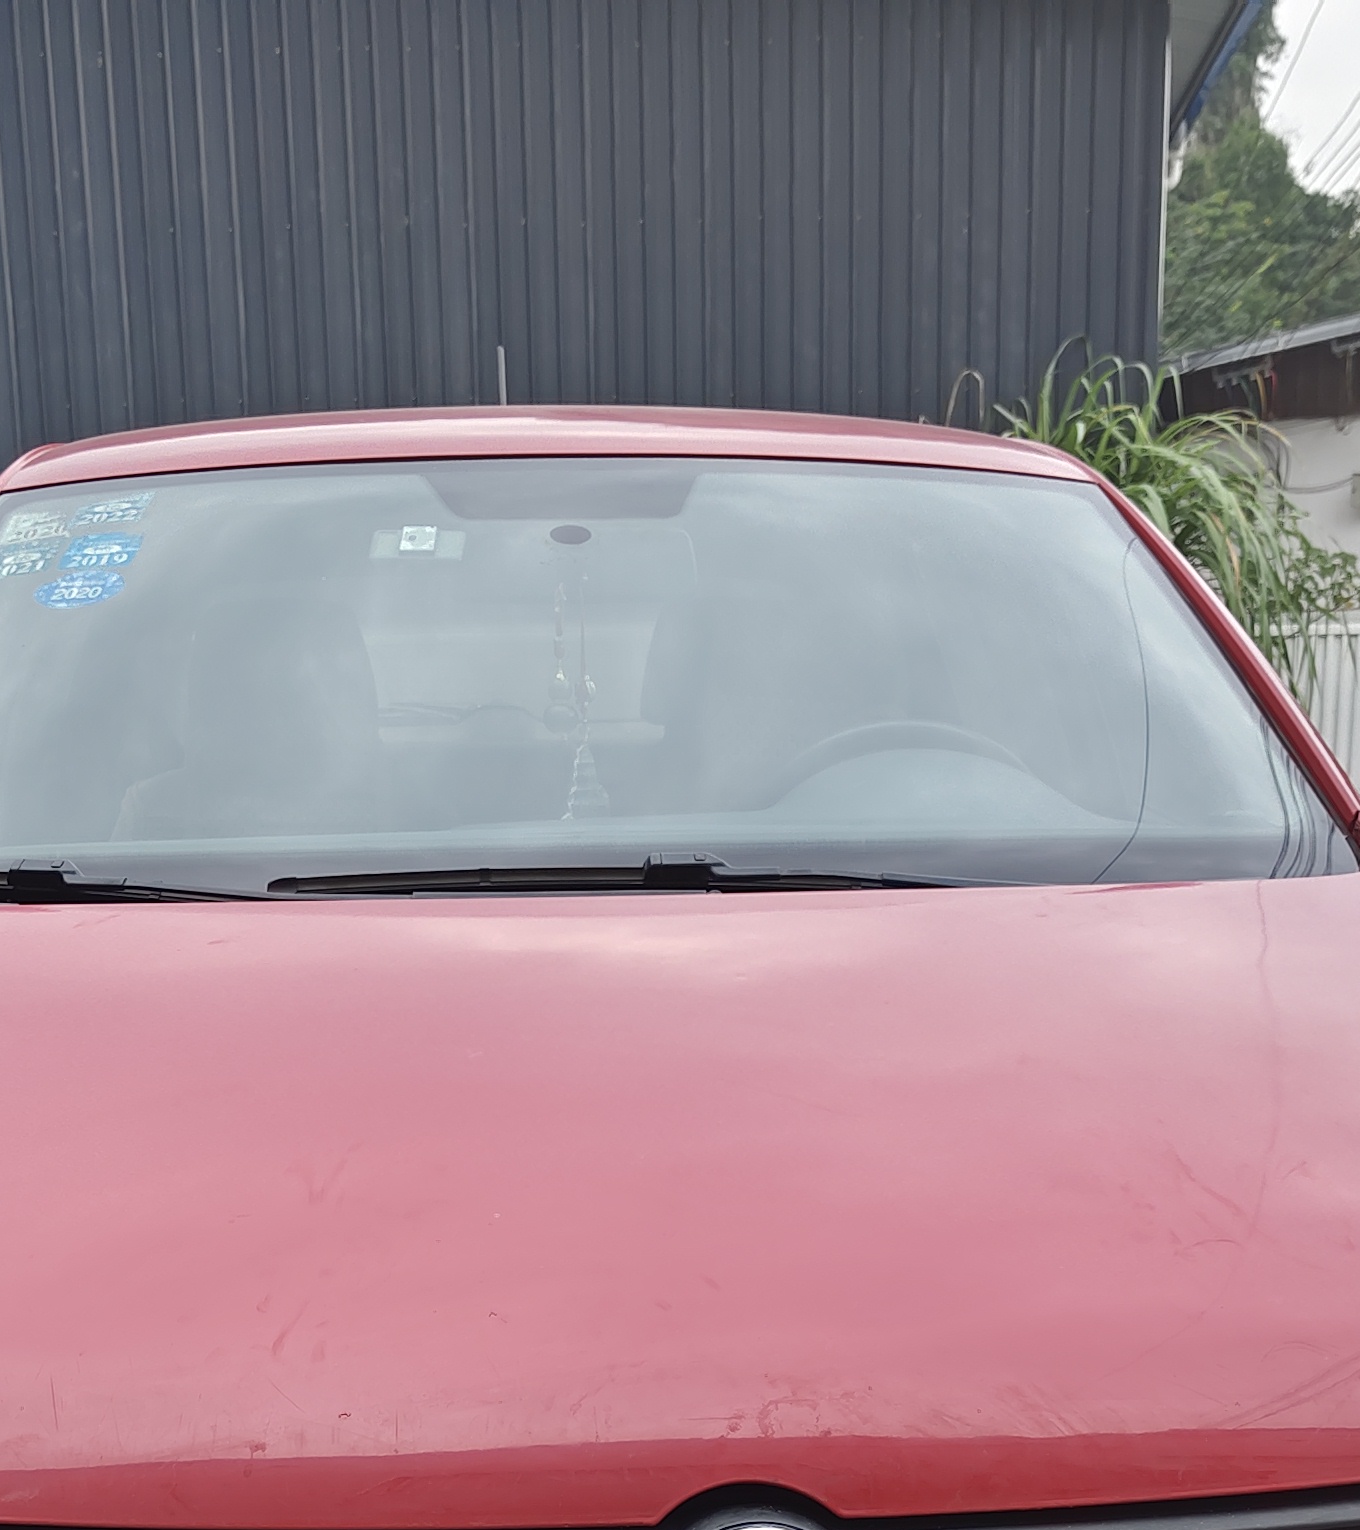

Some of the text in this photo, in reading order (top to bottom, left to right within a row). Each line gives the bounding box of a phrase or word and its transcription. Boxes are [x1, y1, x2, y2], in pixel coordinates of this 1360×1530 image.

[78, 509, 138, 526] 2022
[66, 553, 128, 568] 2019
[51, 586, 104, 601] 2020
